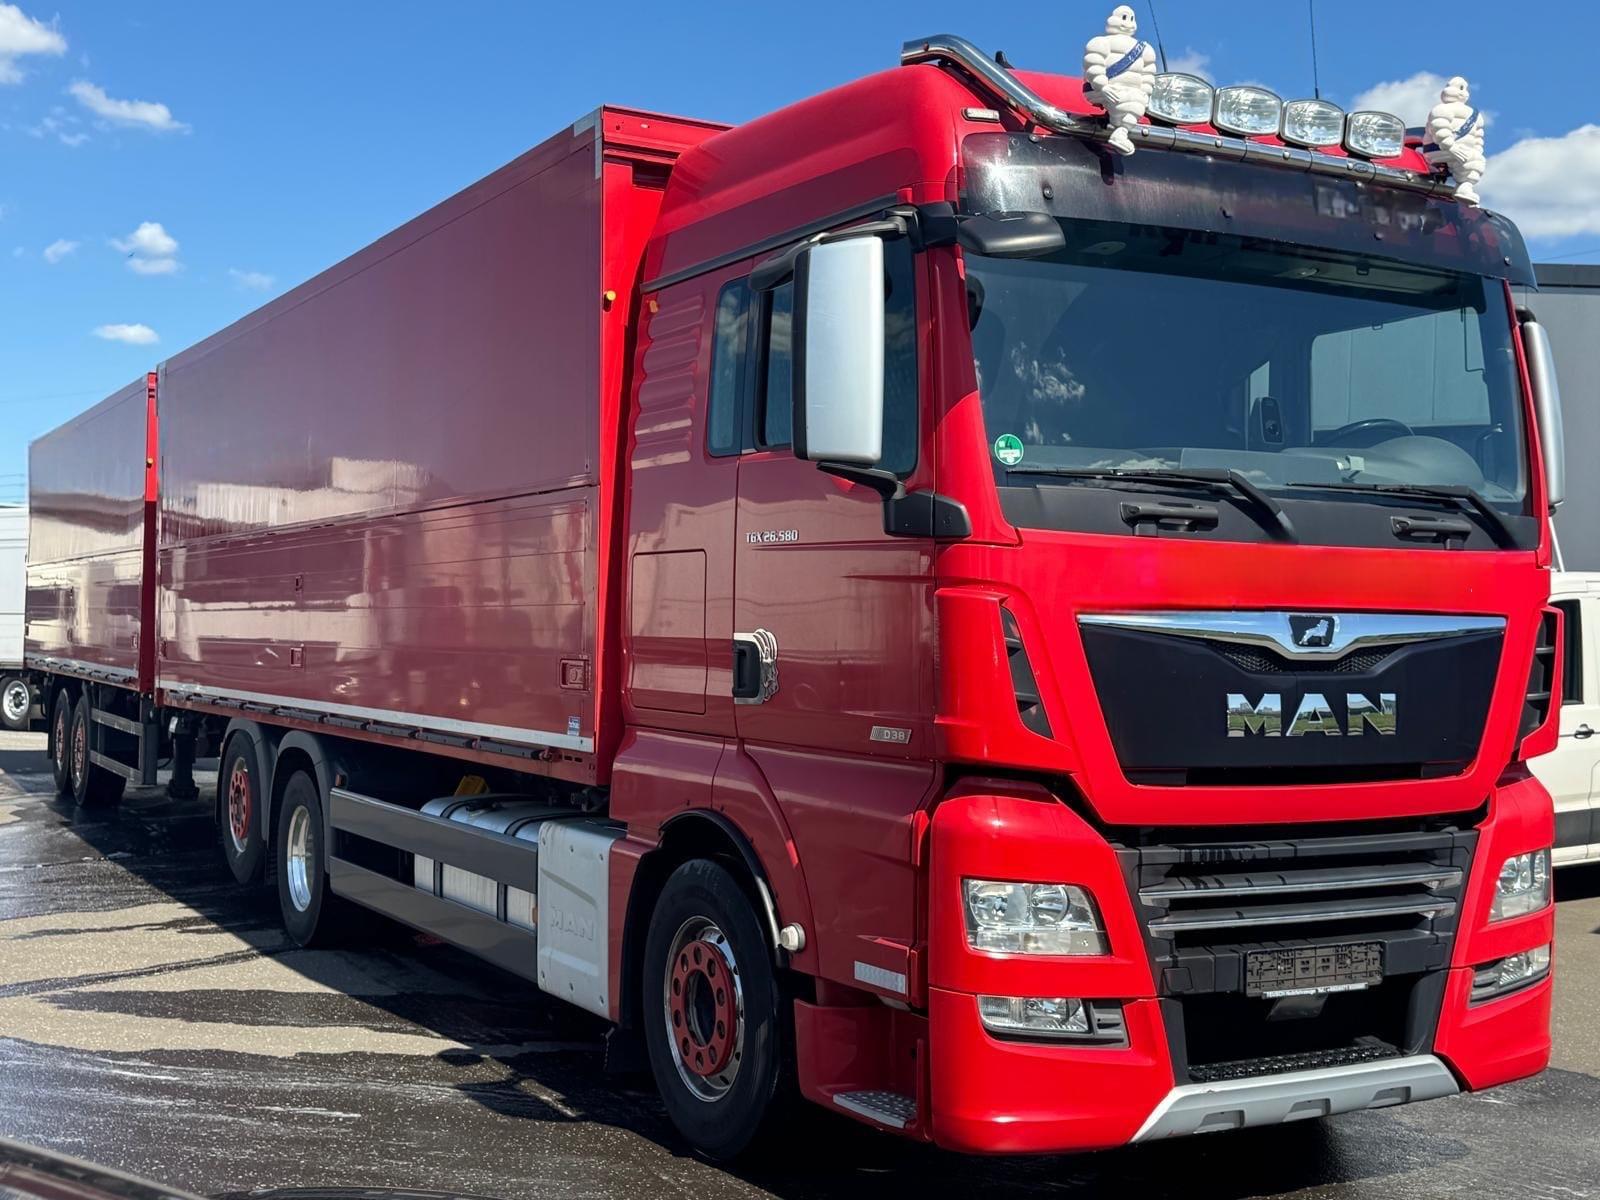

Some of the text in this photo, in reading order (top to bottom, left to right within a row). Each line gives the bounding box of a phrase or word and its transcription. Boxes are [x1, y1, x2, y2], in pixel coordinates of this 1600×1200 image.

[1226, 693, 1397, 737] MAN
[884, 730, 905, 741] D38
[550, 905, 594, 941] MAN
